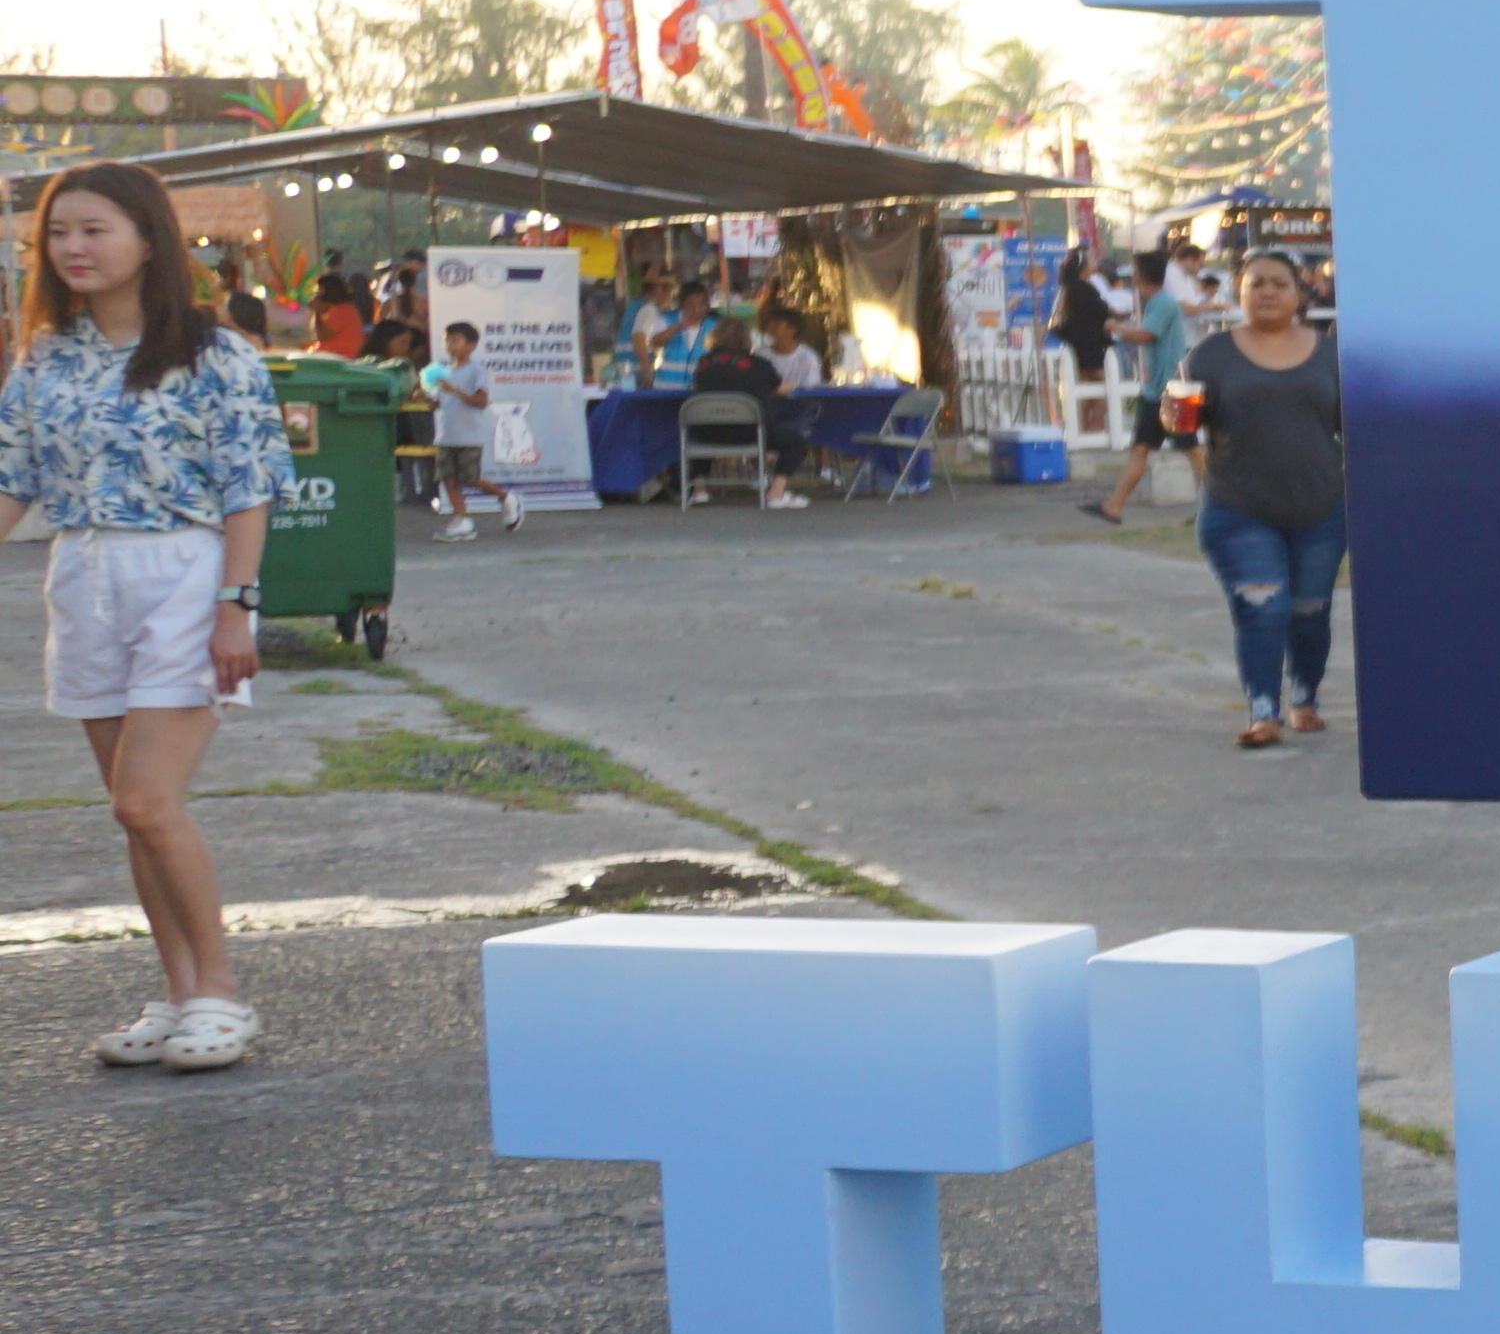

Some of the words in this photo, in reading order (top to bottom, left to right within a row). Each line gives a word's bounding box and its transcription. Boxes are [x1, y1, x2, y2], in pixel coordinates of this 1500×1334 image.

[485, 322, 505, 335] BE
[510, 322, 541, 335] THE
[485, 340, 526, 354] SAVE
[531, 340, 573, 353] LIVES
[485, 359, 574, 371] VOLUNTEER
